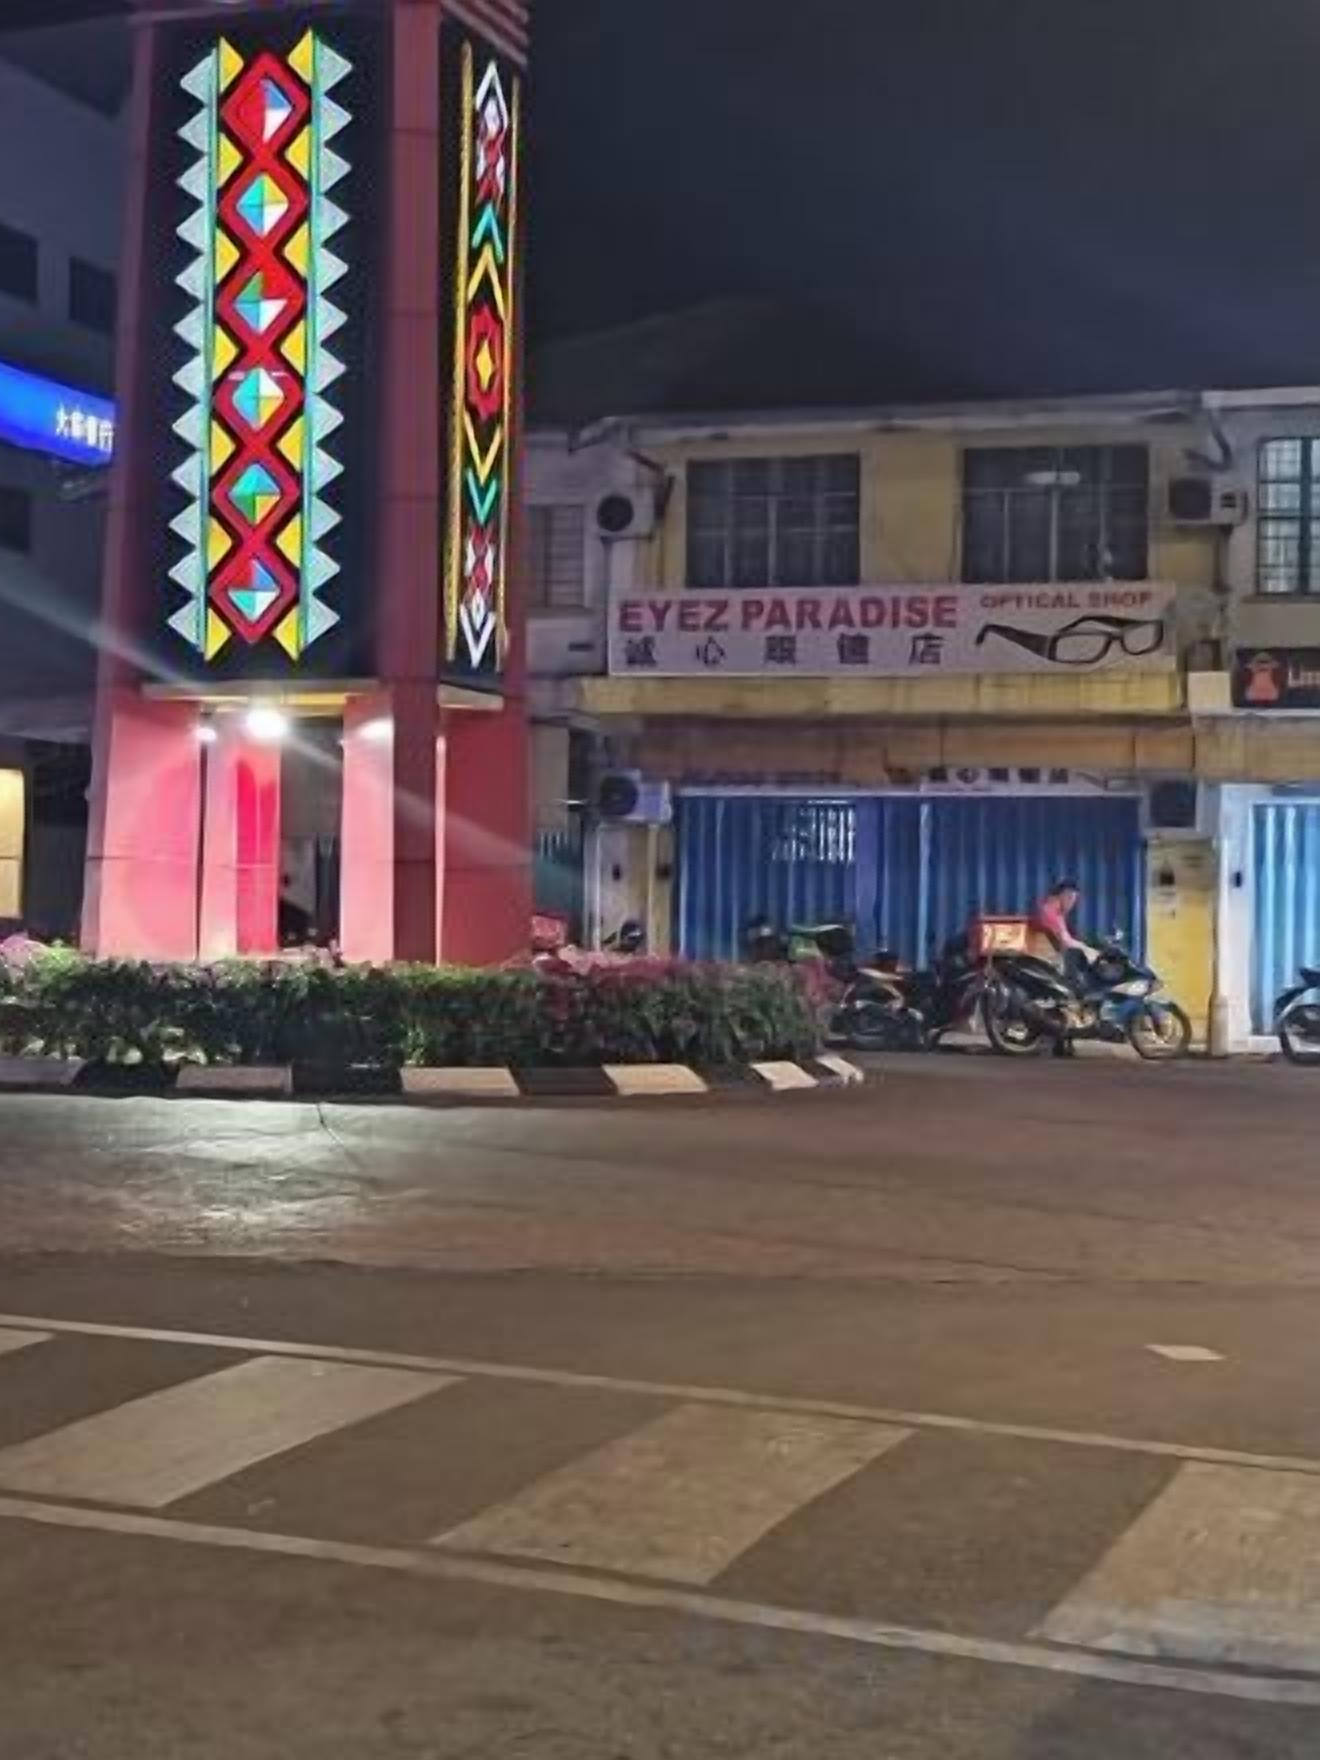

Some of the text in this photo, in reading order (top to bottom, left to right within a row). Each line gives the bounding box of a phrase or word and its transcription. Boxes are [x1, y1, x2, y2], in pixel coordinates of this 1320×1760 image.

[619, 595, 958, 632] EYEZ PARADISE
[980, 590, 1152, 609] OPTICAL SHOP
